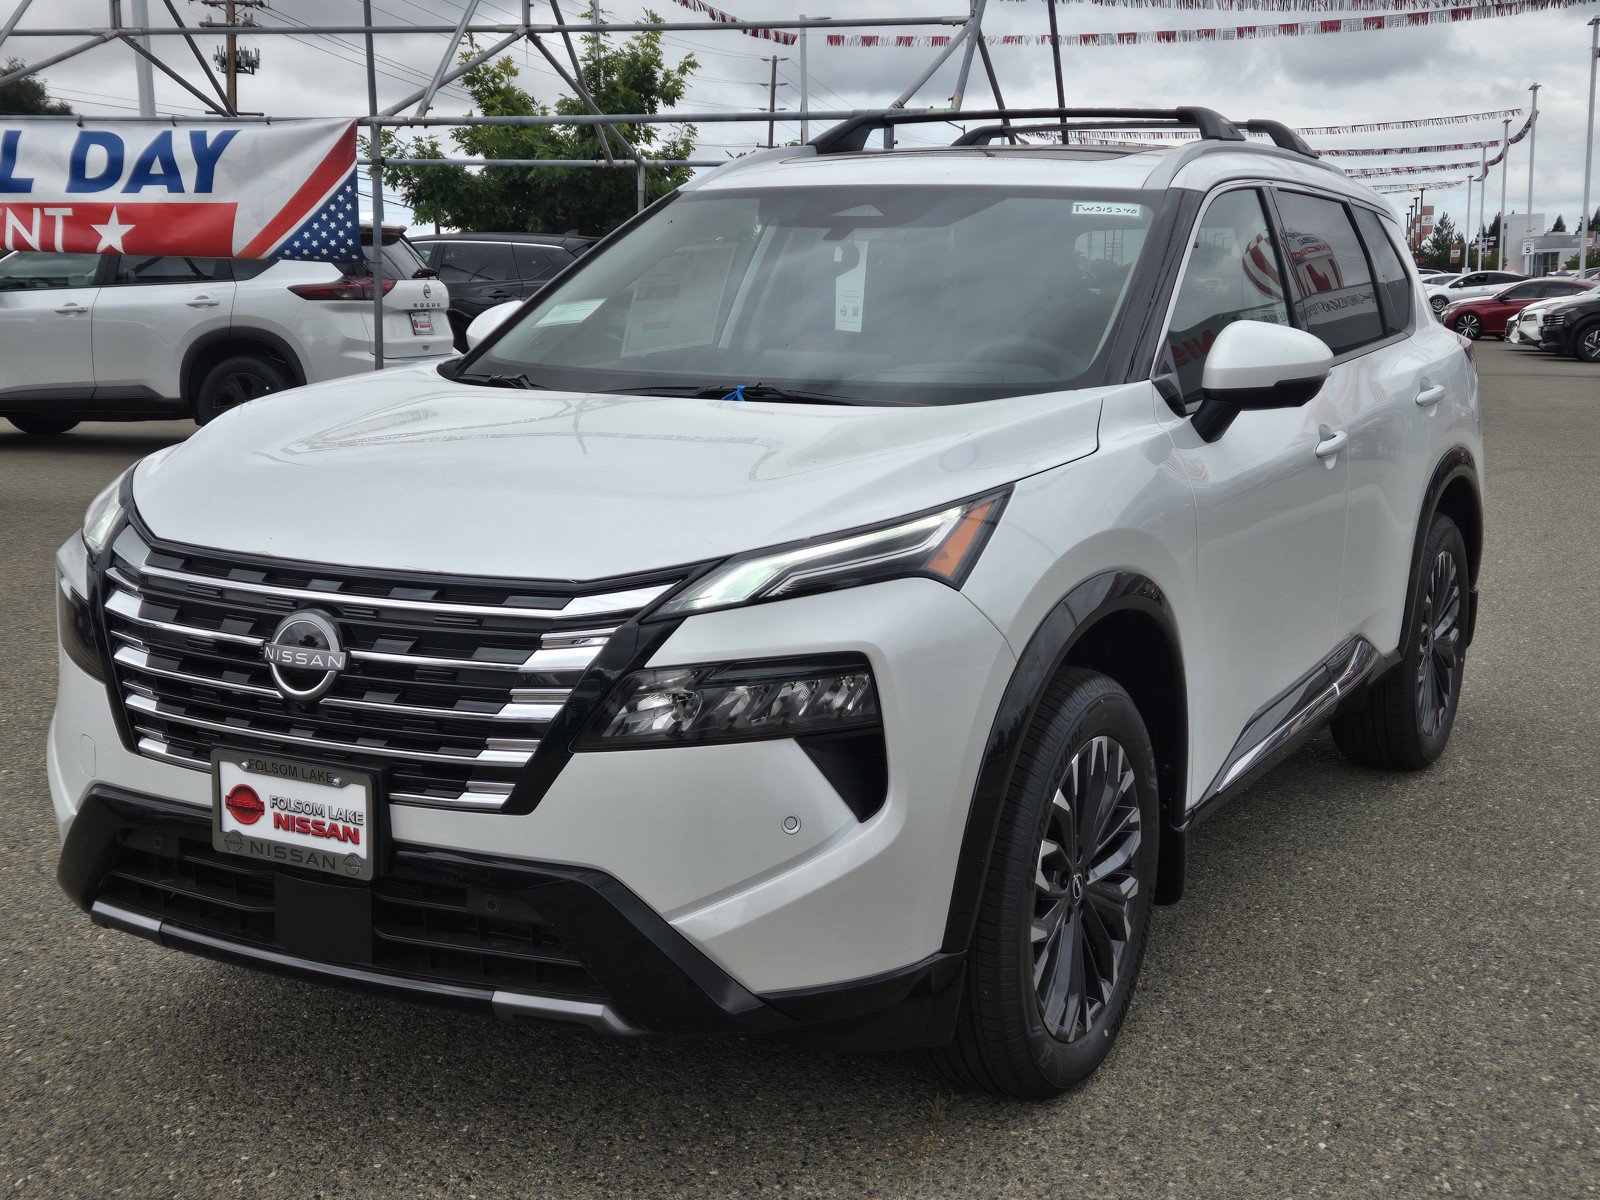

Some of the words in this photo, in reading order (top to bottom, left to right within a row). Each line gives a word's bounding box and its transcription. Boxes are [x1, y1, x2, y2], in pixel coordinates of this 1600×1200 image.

[65, 130, 242, 193] DAY
[0, 206, 74, 253] NT
[264, 646, 343, 668] NISSAN
[248, 758, 298, 778] FOLSOM
[301, 768, 334, 785] LAKE
[269, 795, 326, 818] FOLSOM
[328, 805, 364, 826] LAKE
[273, 811, 360, 846] NISSAN
[250, 840, 336, 870] NISSAN
